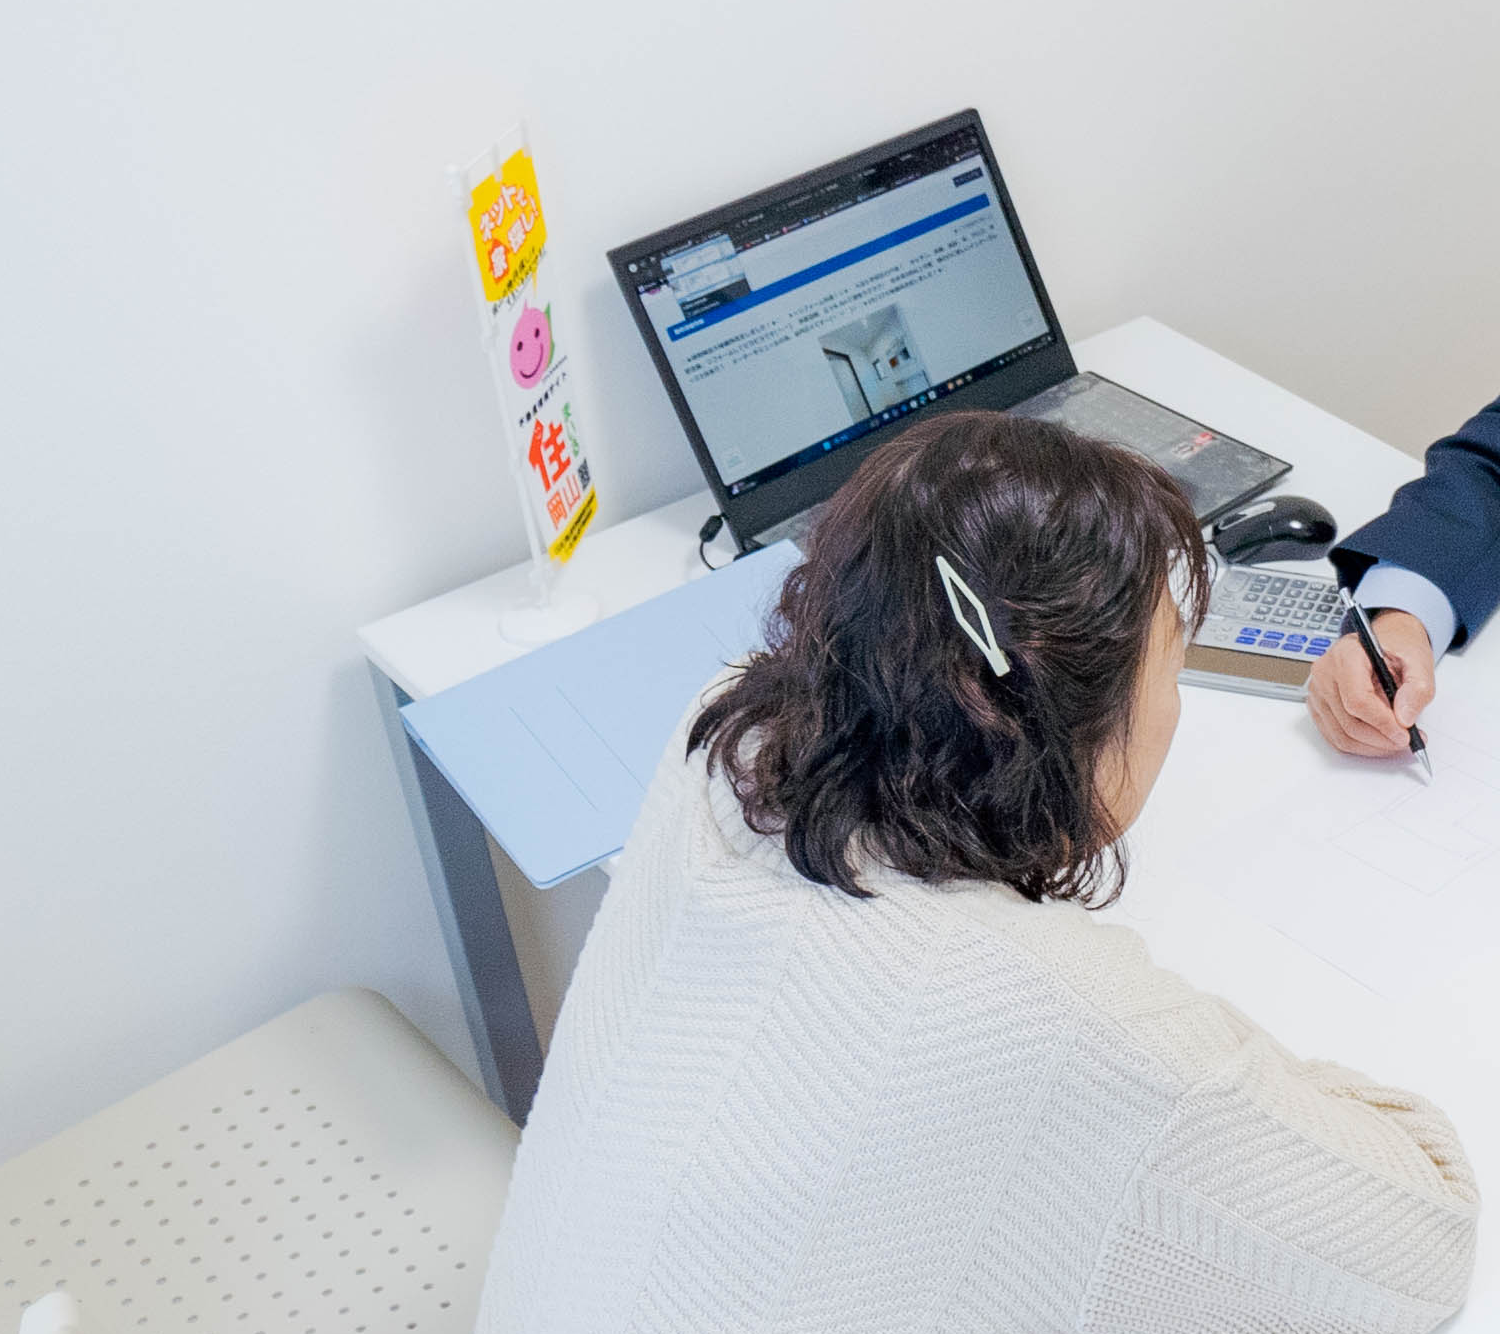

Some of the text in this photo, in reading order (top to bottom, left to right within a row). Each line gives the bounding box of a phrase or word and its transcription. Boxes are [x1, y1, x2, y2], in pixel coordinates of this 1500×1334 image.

[479, 182, 529, 241] ネットで
[547, 475, 581, 530] 岡山
